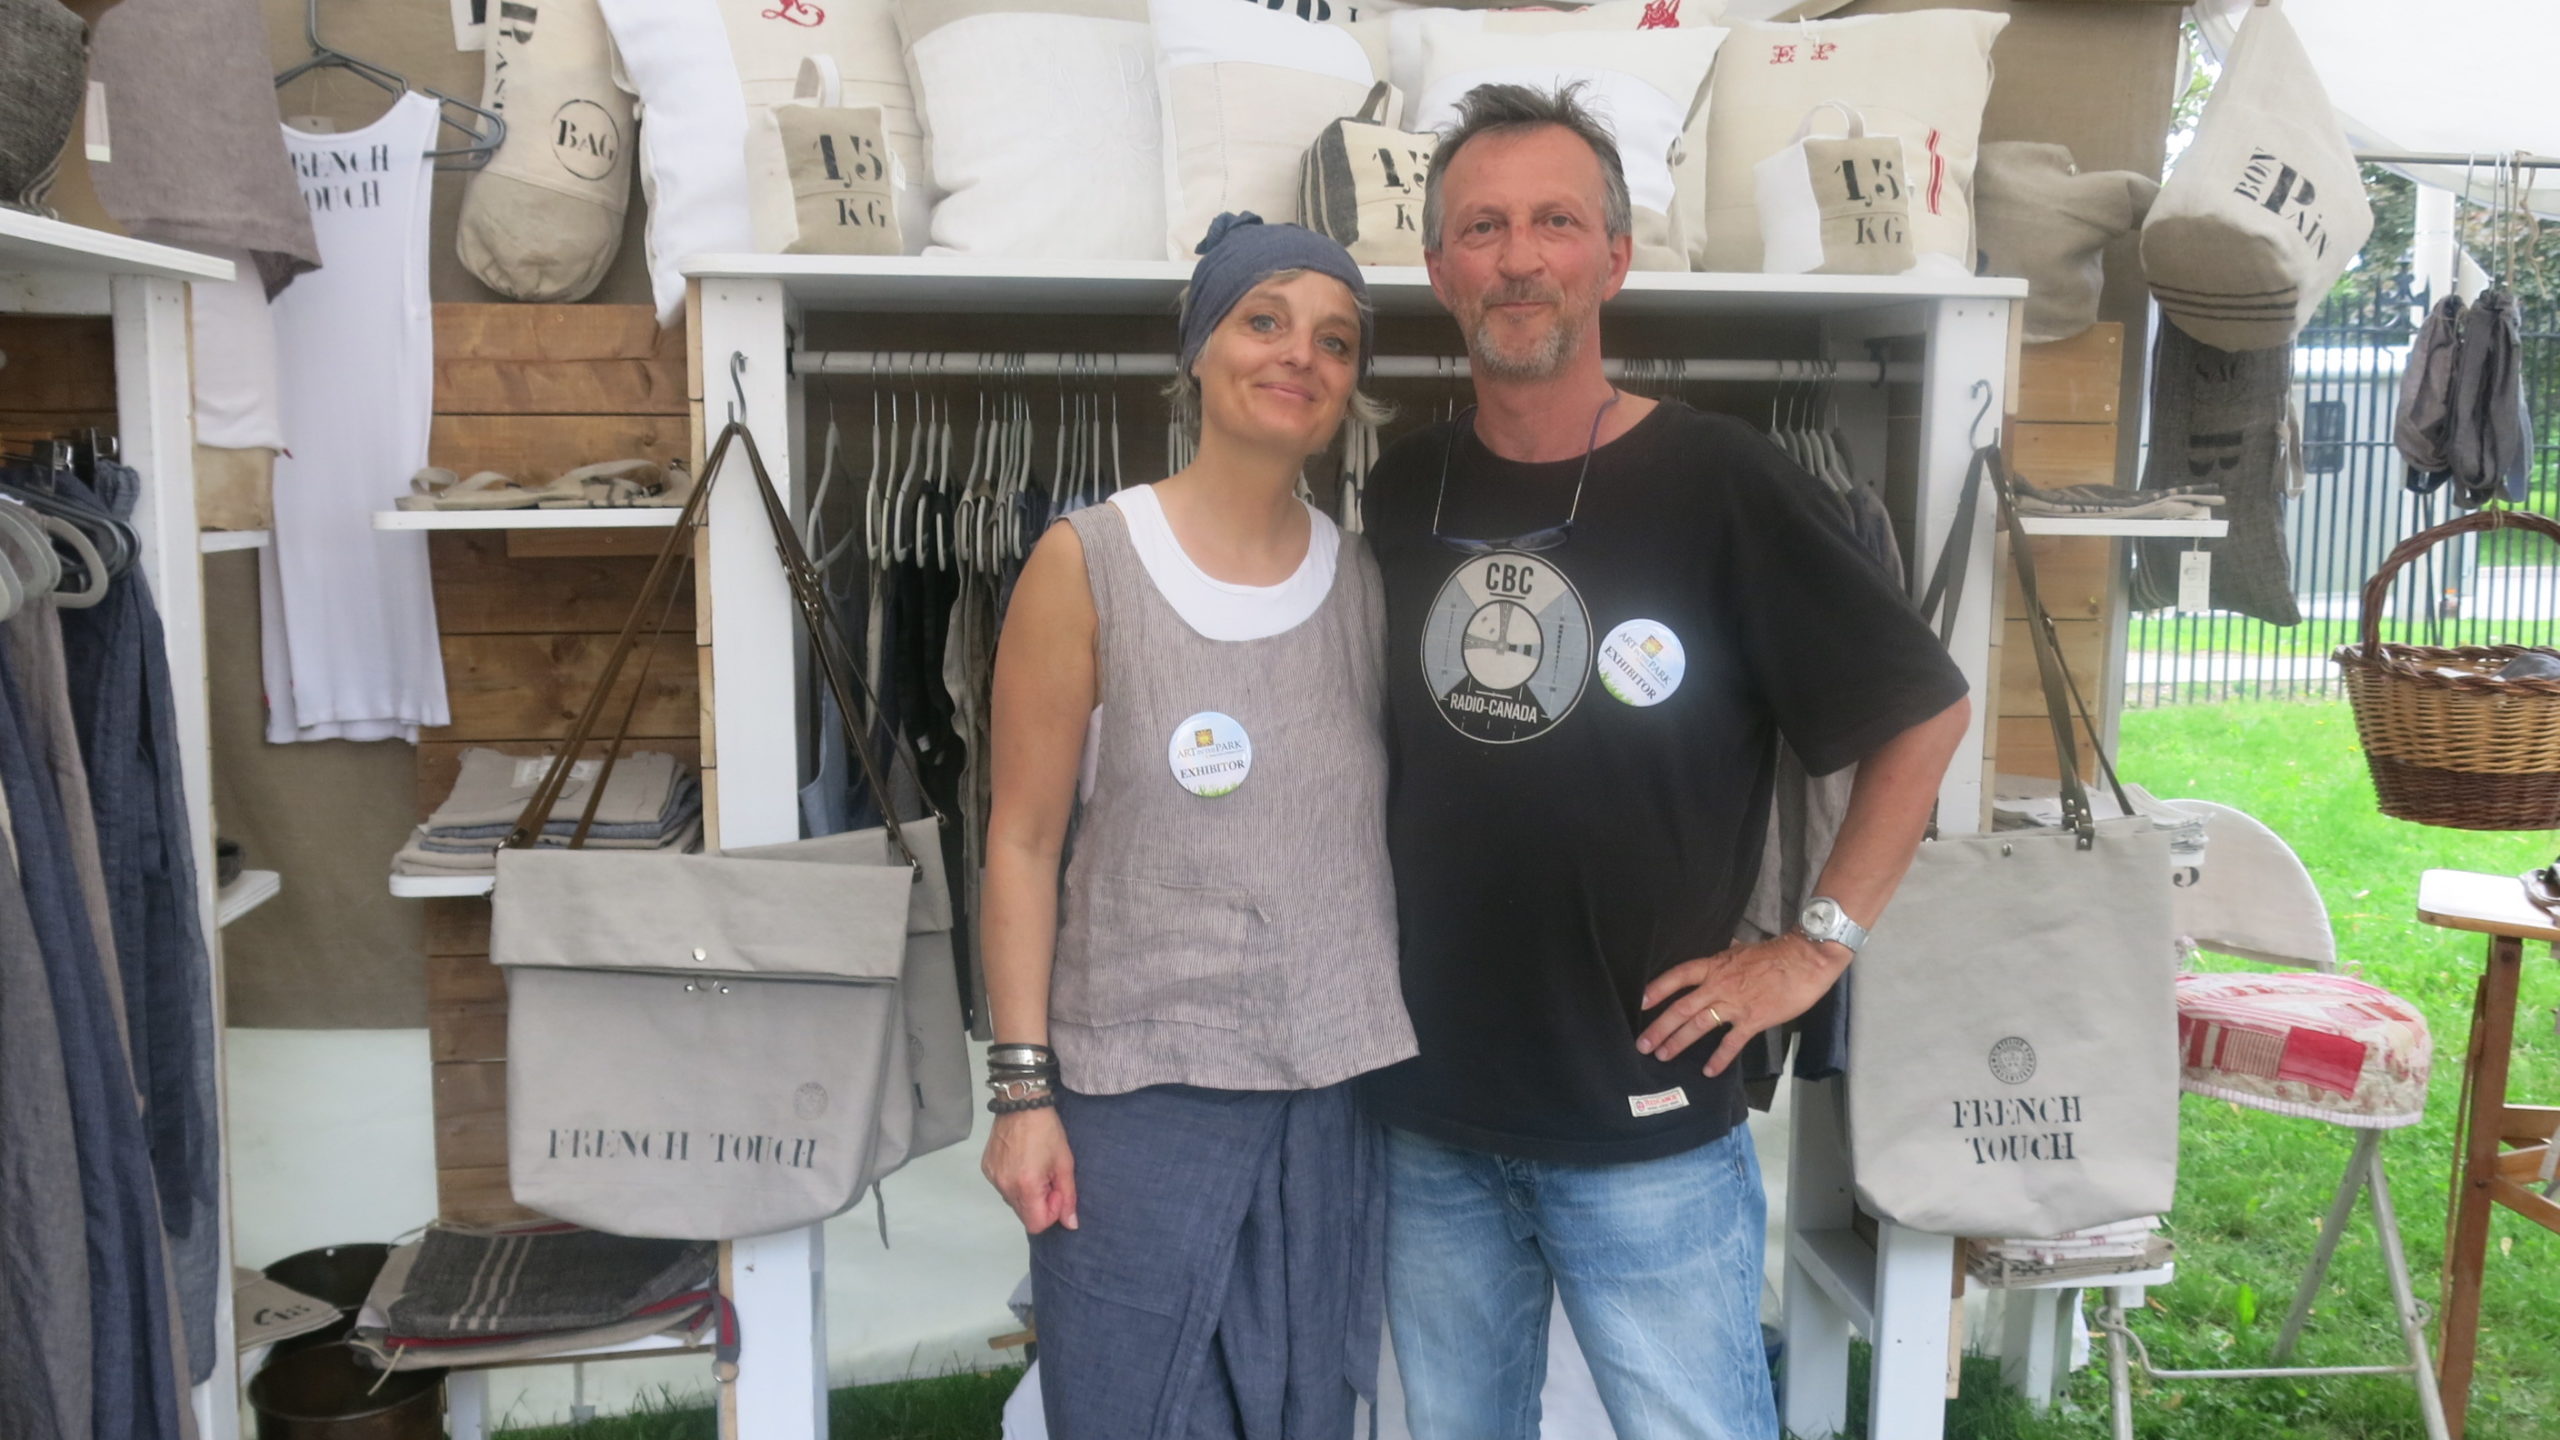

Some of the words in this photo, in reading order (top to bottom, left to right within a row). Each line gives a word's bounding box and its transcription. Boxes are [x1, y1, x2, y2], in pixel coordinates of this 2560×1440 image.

[556, 118, 614, 161] BAG
[290, 144, 389, 178] RENCH
[2233, 146, 2277, 202] BON
[303, 180, 380, 212] OUCH
[835, 198, 886, 228] KG
[1395, 203, 1424, 232] K
[1855, 216, 1903, 245] KG
[1485, 562, 1534, 595] CBC
[1604, 645, 1657, 699] EXHIBITOR
[1450, 692, 1538, 724] RADIO-CANADA
[1215, 740, 1242, 754] PARK
[1180, 759, 1246, 779] EXHIBITOR
[1952, 1096, 2082, 1128] FRENCH
[548, 1128, 689, 1161] FRENCH
[710, 1133, 817, 1169] TOUCH
[1965, 1132, 2076, 1164] TOUCH
